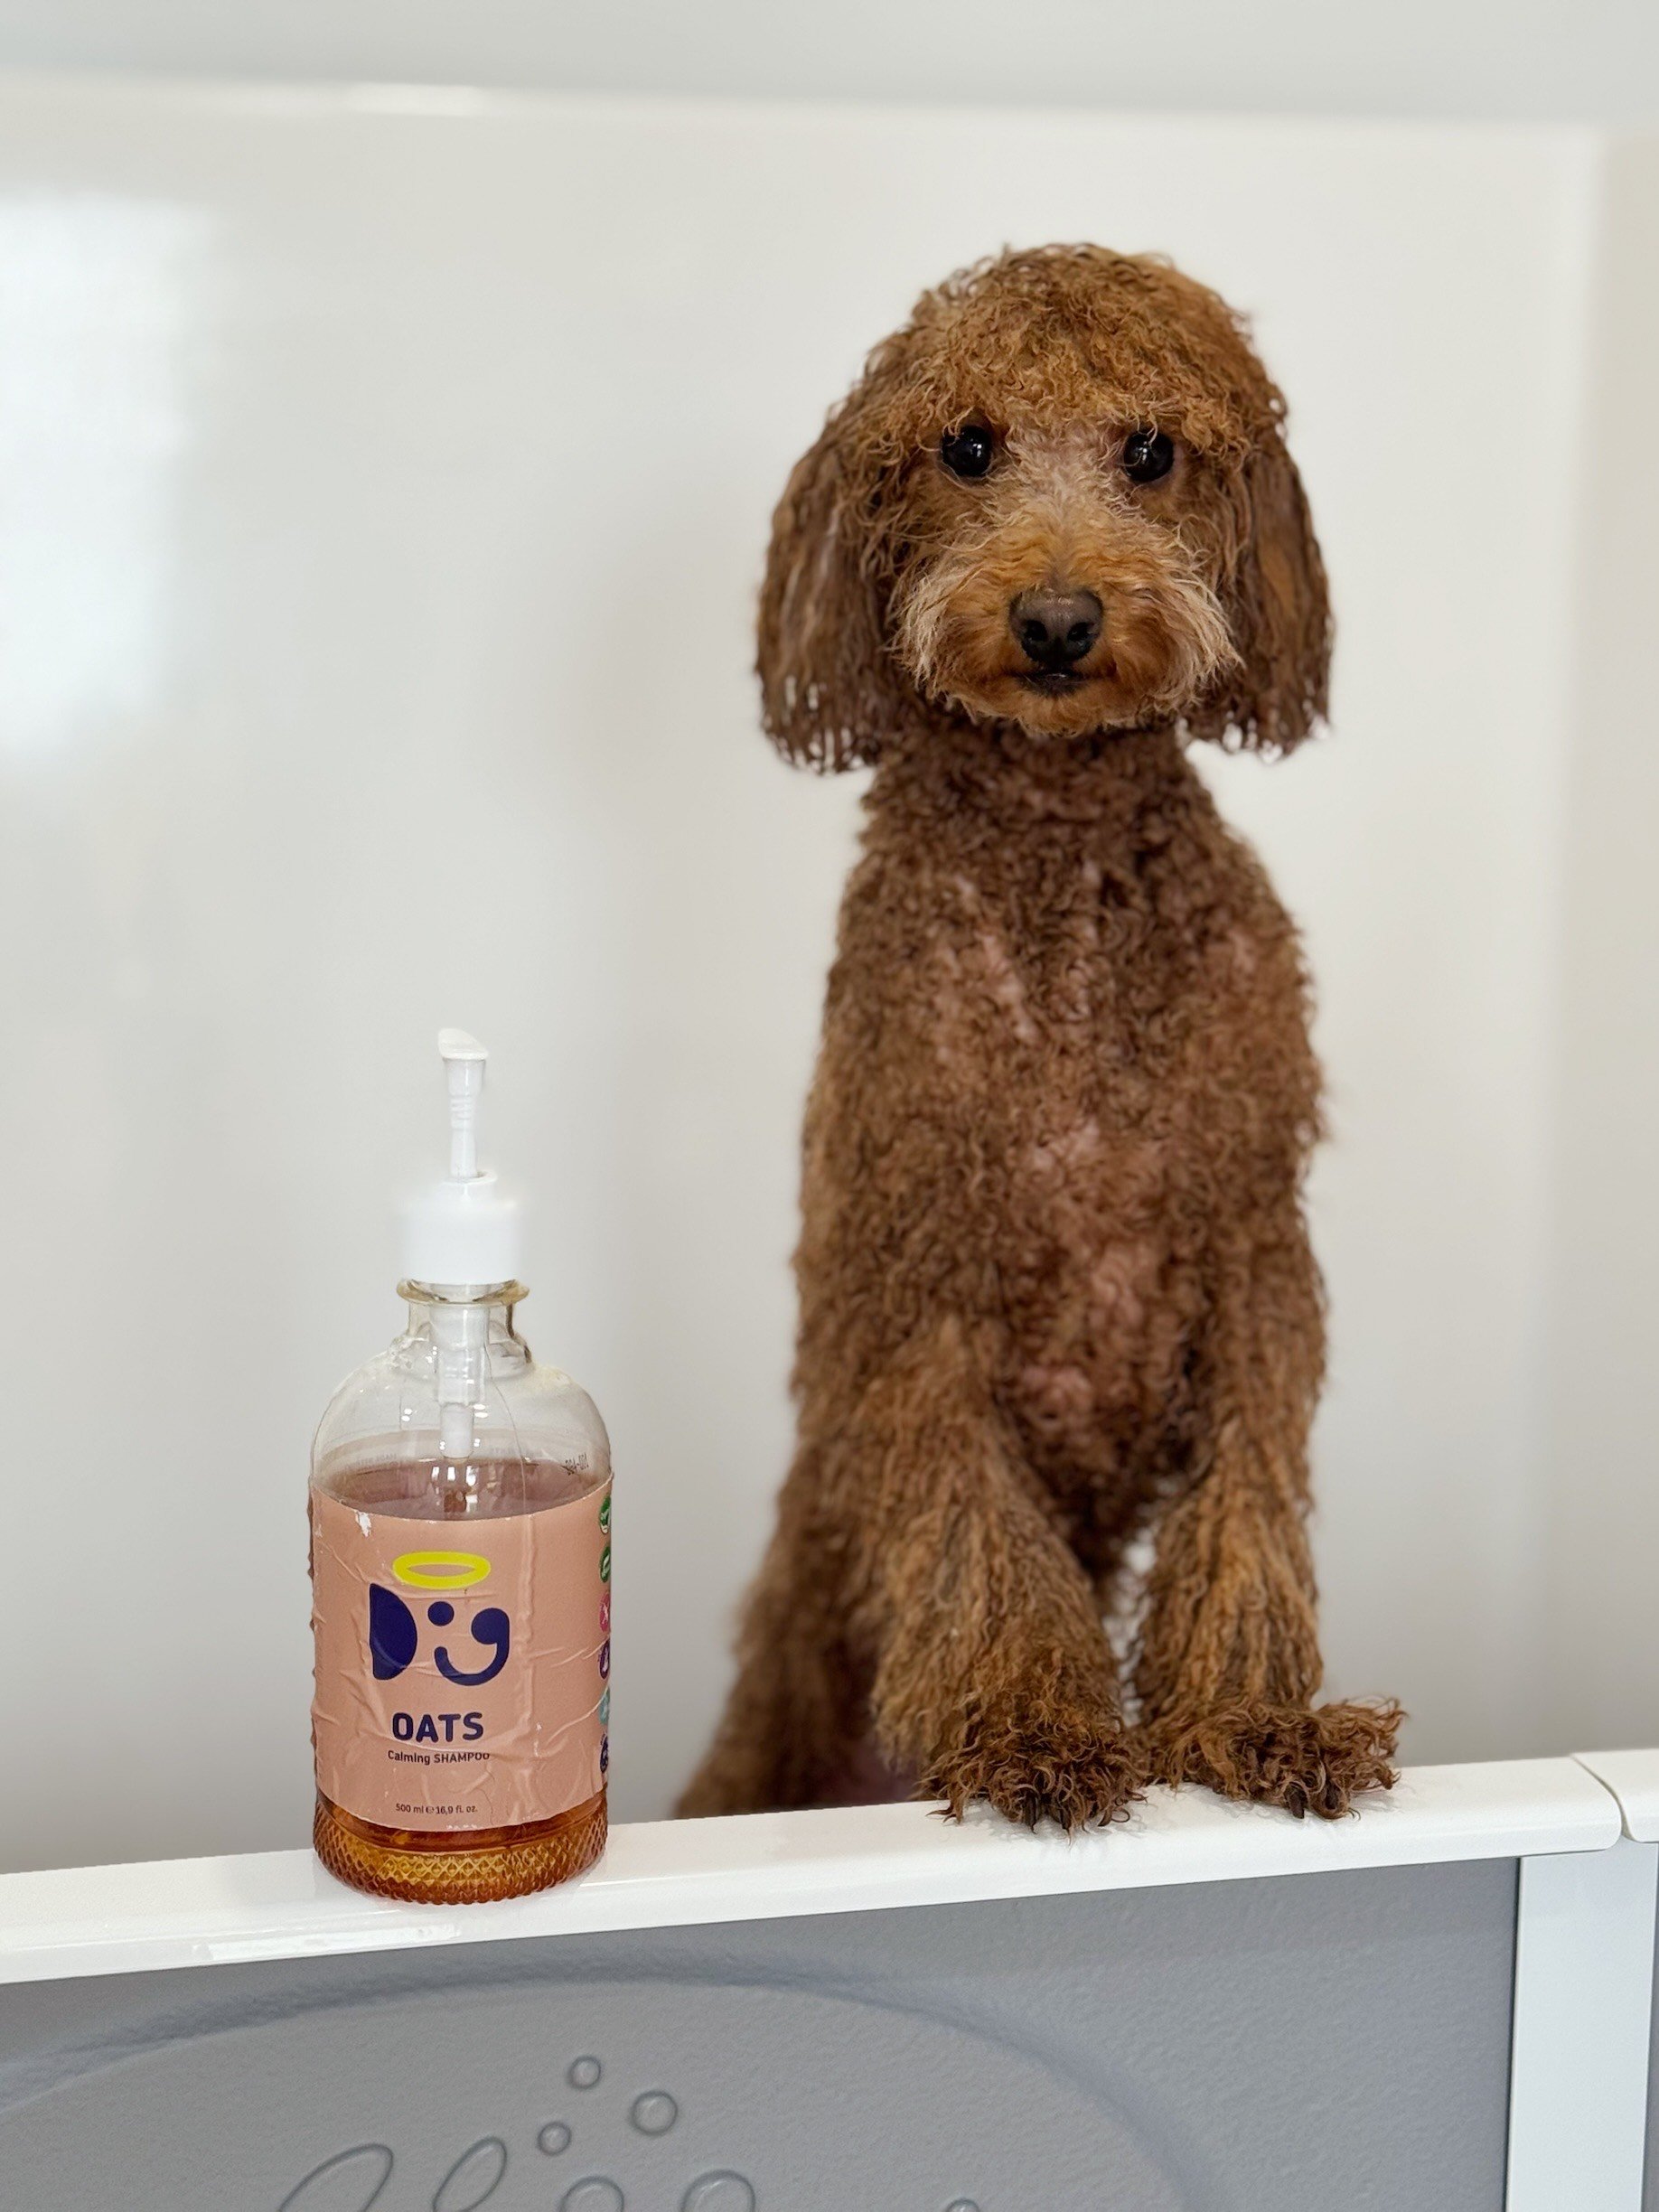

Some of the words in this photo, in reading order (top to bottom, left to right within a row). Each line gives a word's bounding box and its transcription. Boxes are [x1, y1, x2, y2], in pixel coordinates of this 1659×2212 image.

[392, 1712, 483, 1742] OATS
[388, 1750, 430, 1766] Calming
[434, 1752, 490, 1763] SHAMPOO
[396, 1804, 411, 1813] 500
[413, 1805, 424, 1814] ml
